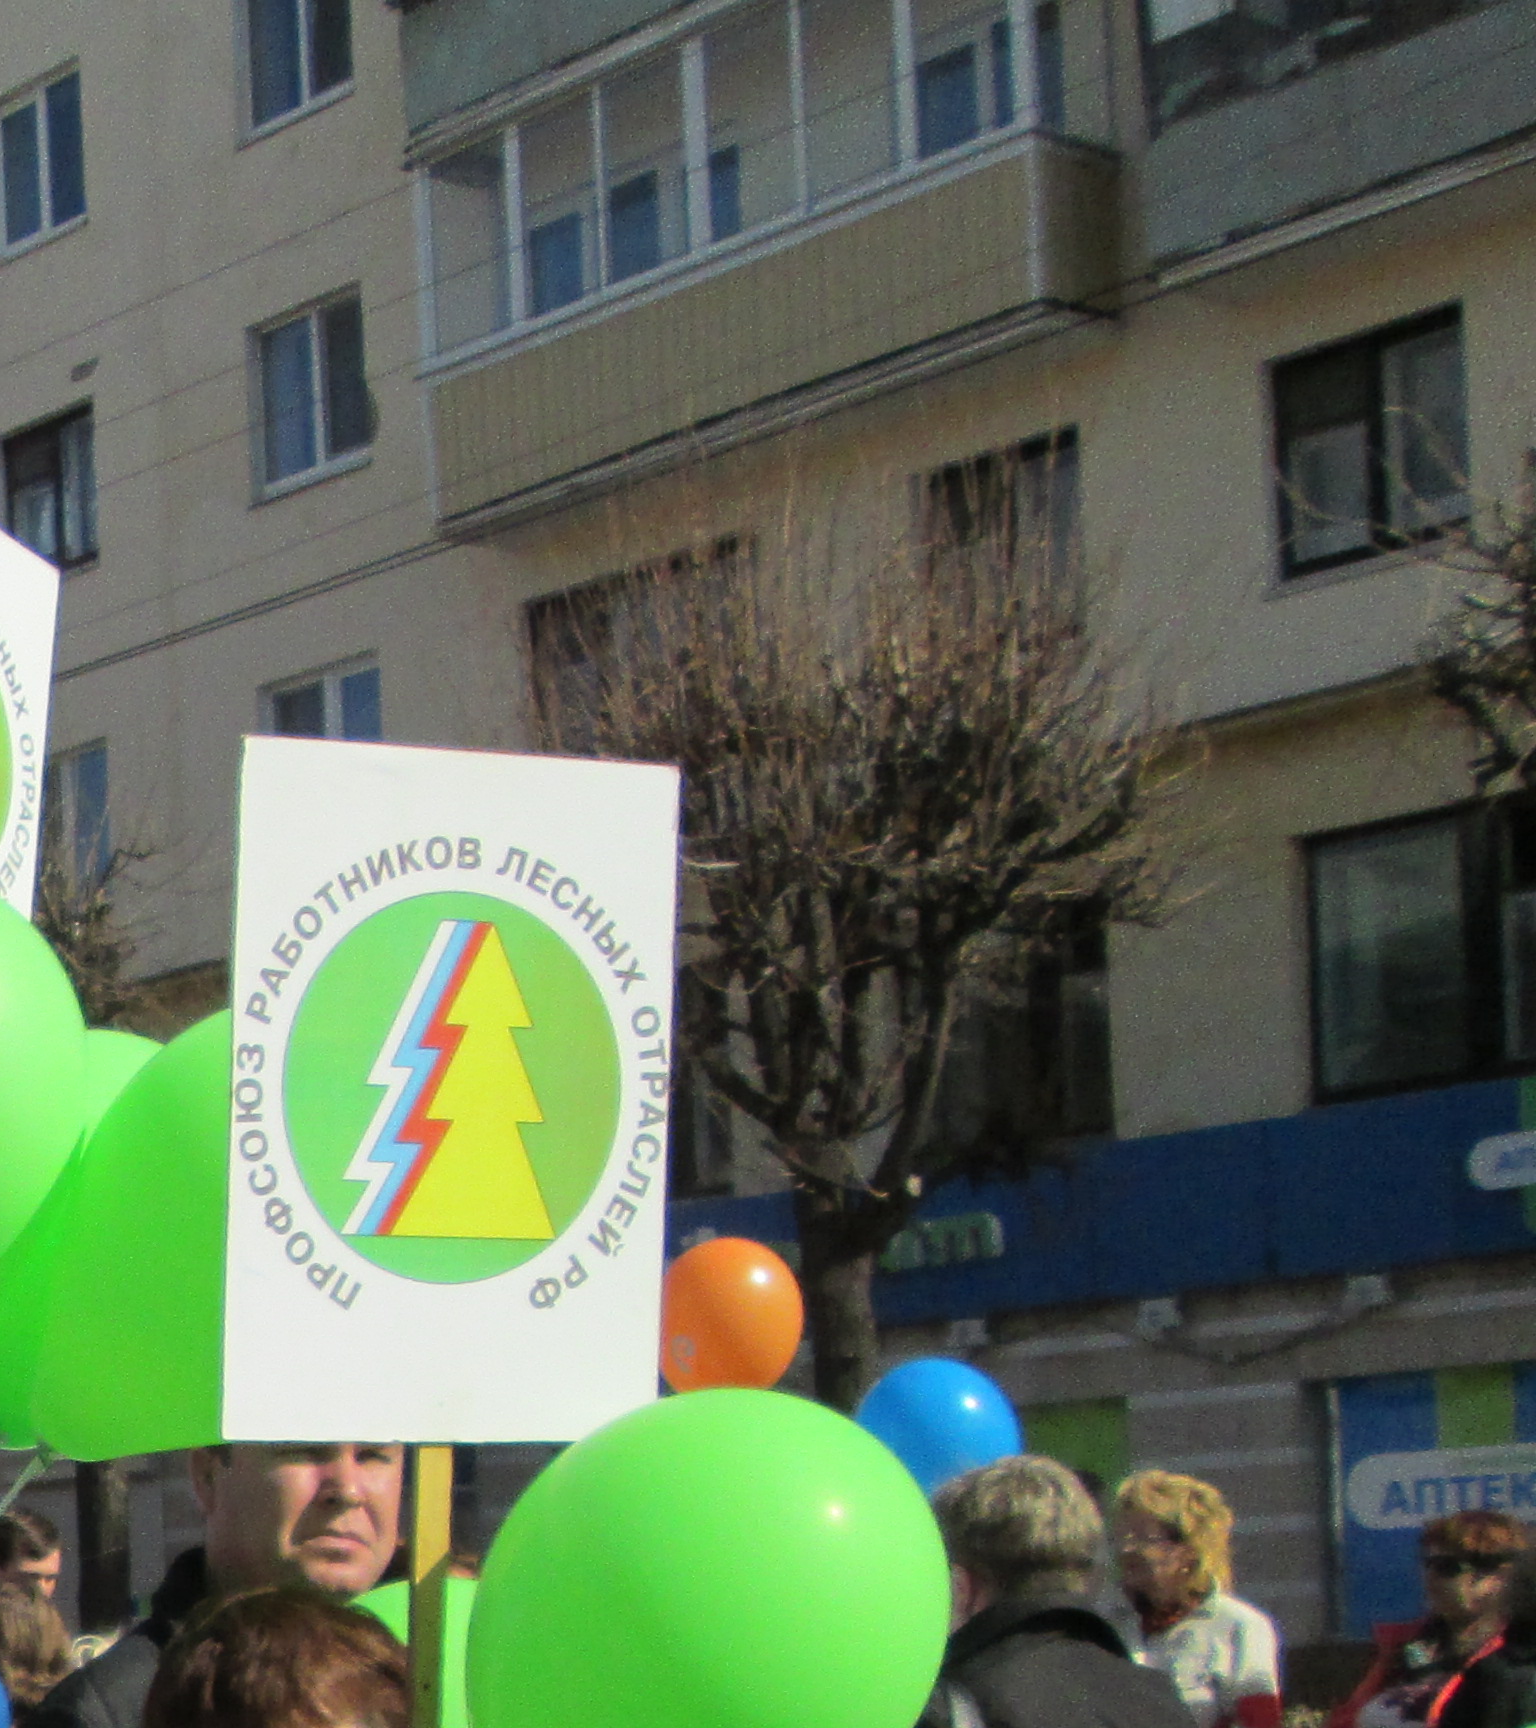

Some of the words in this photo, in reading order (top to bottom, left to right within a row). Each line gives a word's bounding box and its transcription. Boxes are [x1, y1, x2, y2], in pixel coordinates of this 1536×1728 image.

[246, 836, 481, 1025] РАБОТНИКОВ
[495, 844, 649, 993] ЛЕСНЫХ
[234, 1043, 362, 1311] ПРОФСОЮЗ
[592, 1004, 670, 1260] ОТРАСЛЕЙ
[528, 1255, 588, 1311] РФ
